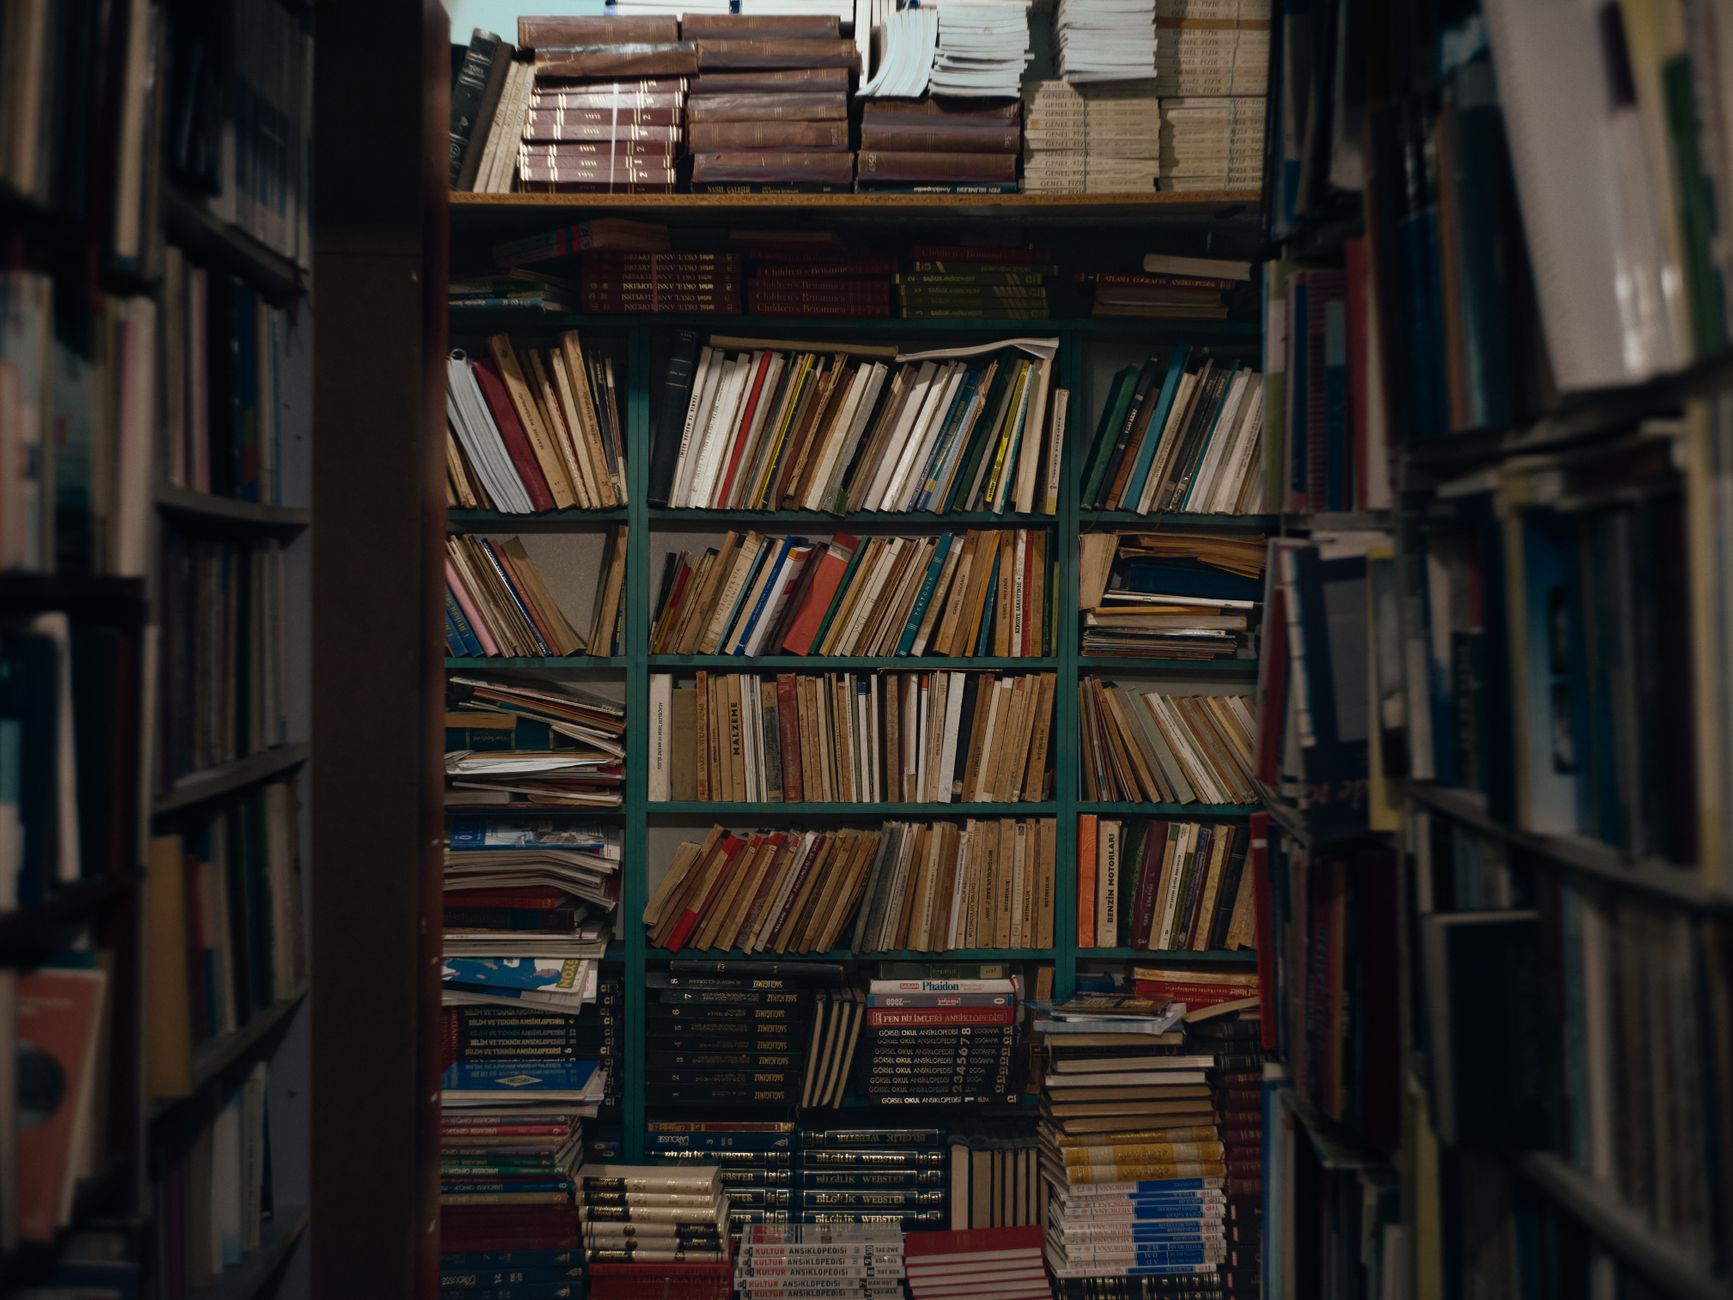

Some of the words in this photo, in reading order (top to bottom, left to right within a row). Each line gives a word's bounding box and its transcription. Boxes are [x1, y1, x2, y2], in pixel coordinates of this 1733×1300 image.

[730, 702, 740, 756] MALZEME
[922, 981, 959, 991] Phaidon
[884, 1014, 899, 1023] FEN
[901, 1013, 942, 1023] BİLİMLERİ
[958, 1048, 968, 1056] 6
[657, 1136, 689, 1146] LAROUSSE
[816, 1153, 856, 1162] BİLGİLİK
[816, 1174, 856, 1183] BİLGİLİK
[862, 1175, 904, 1183] WEBSTER
[816, 1194, 856, 1203] BİLGİLİK
[863, 1195, 905, 1204] WEBSTER
[815, 1214, 855, 1223] BİLGİLİK
[861, 1215, 903, 1223] WEBSTER
